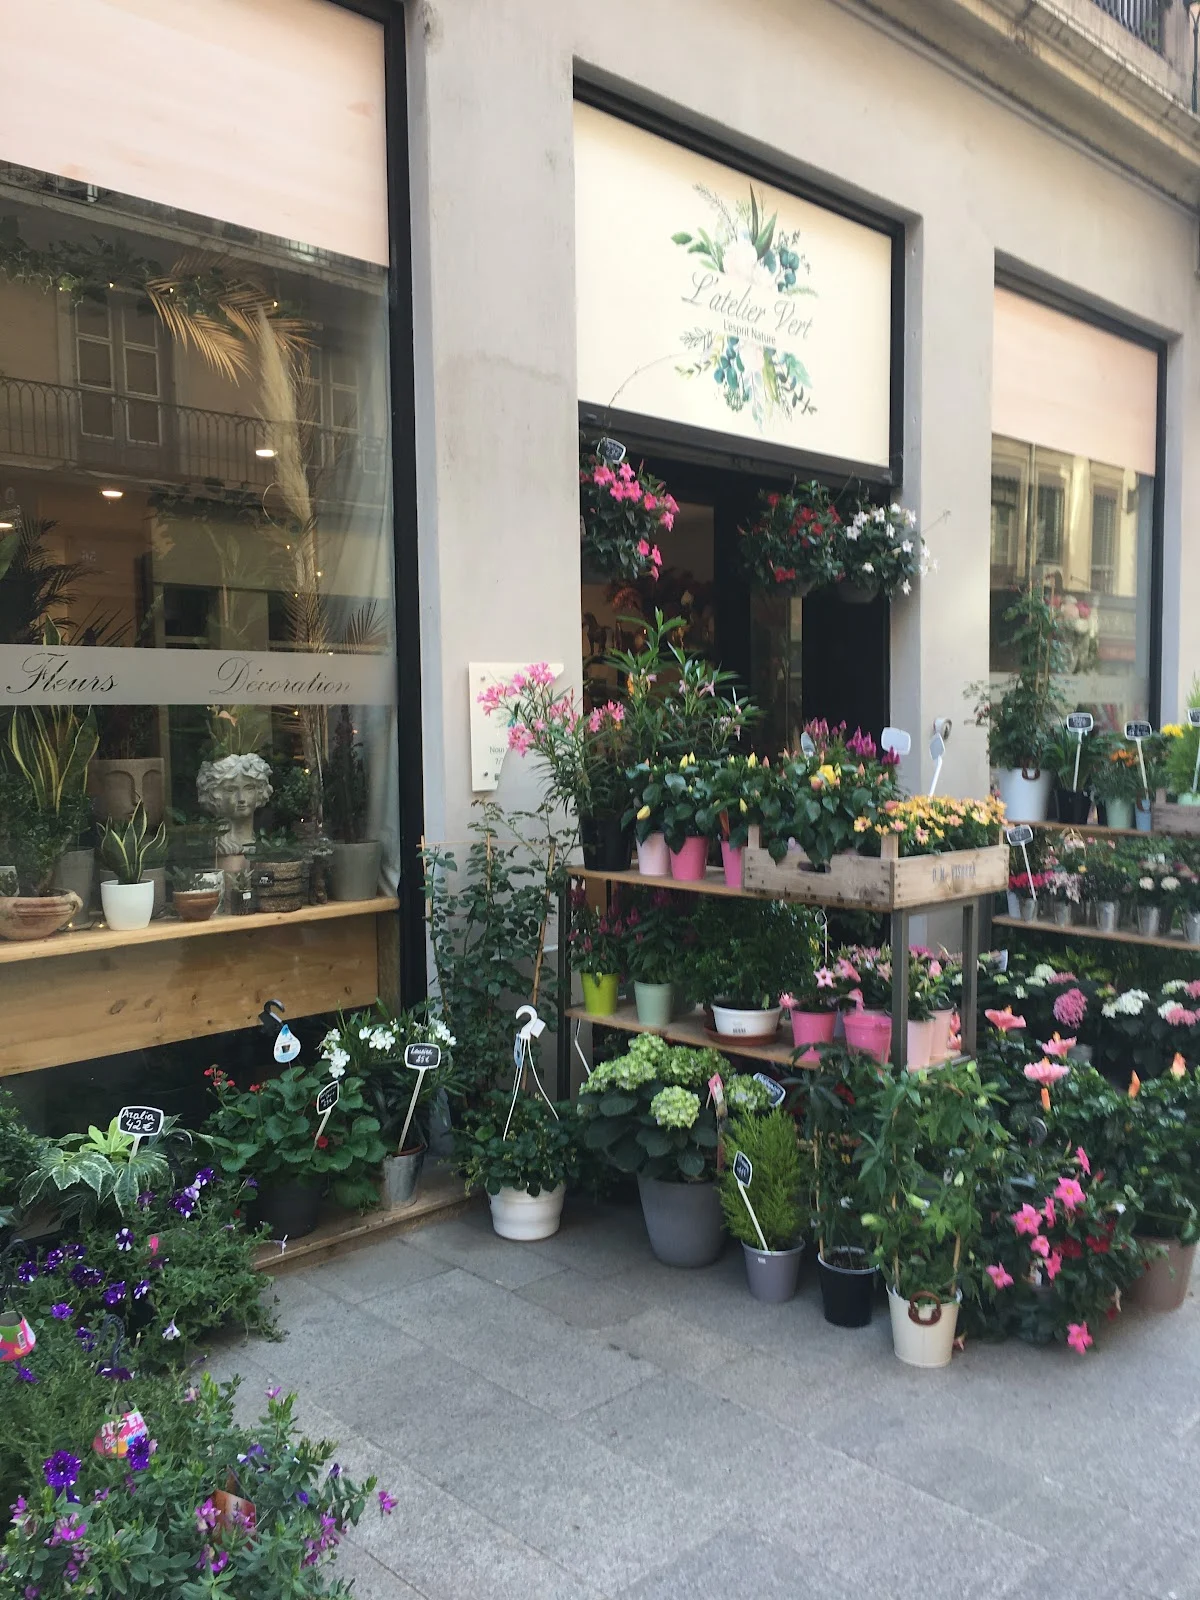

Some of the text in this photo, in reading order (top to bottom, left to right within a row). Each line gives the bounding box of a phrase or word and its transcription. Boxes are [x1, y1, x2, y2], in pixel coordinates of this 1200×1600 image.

[681, 271, 813, 340] L'atelier Vert
[751, 326, 776, 346] Nature
[6, 652, 351, 695] Fleurs Décoration
